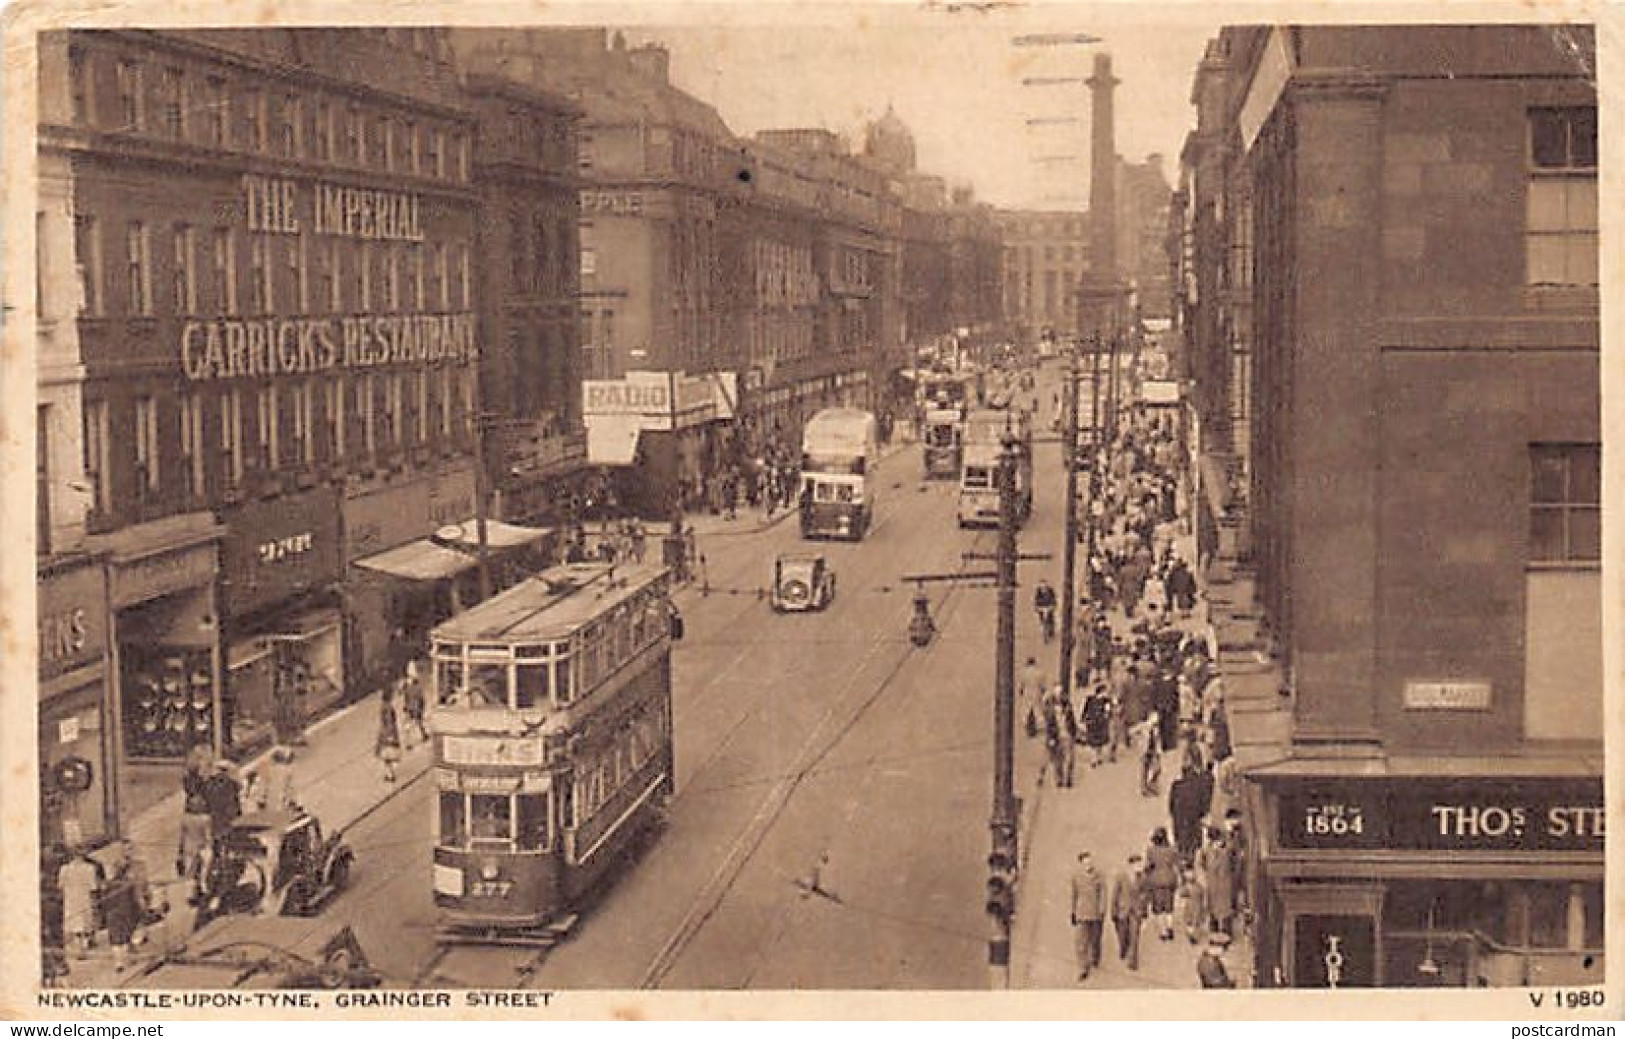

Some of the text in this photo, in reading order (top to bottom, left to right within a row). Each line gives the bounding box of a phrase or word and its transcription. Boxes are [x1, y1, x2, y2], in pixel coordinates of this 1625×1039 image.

[242, 175, 424, 242] THE IMPERIAL
[588, 384, 667, 408] RADIO
[1305, 813, 1364, 835] 1864
